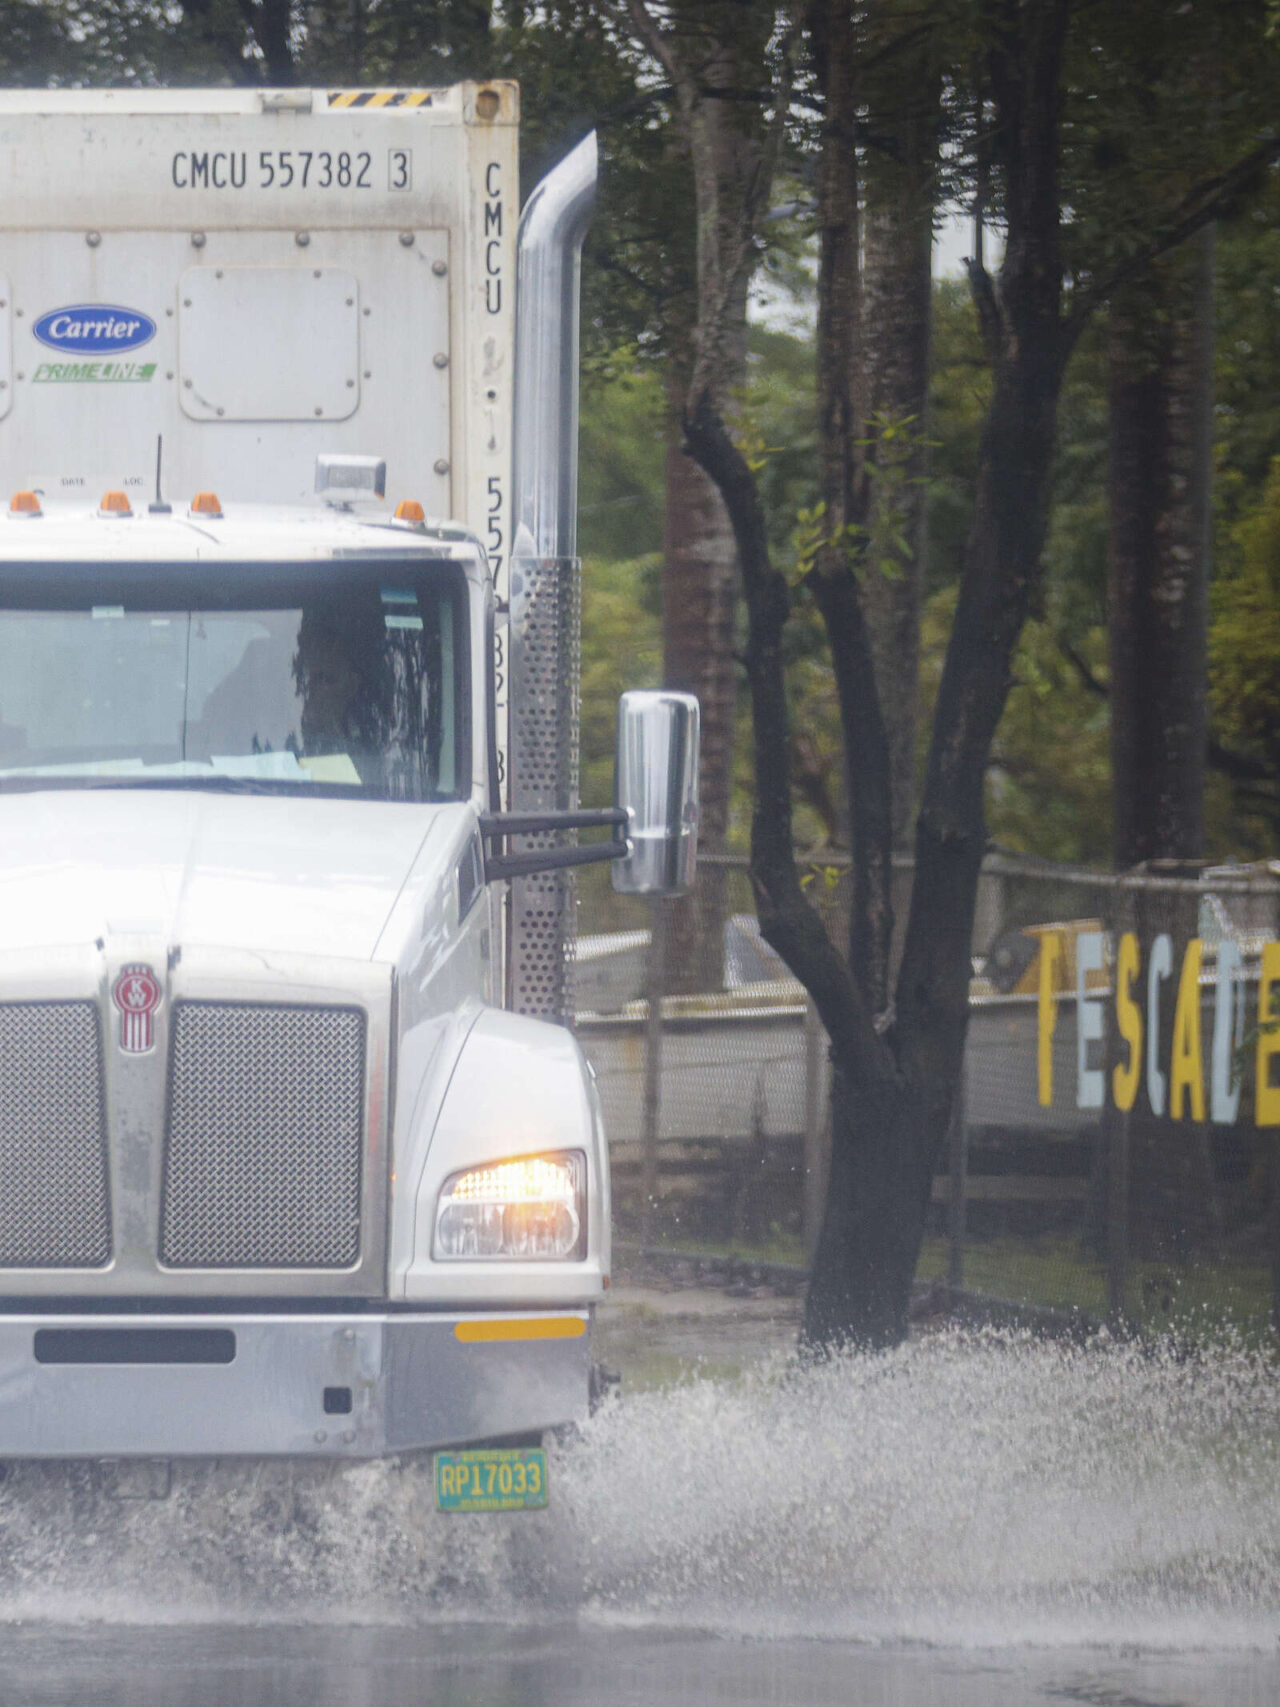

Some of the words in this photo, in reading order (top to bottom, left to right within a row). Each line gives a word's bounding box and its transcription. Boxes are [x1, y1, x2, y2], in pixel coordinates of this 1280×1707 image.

[172, 152, 246, 188] CMCU
[259, 152, 372, 188] 557382
[393, 152, 408, 188] 3
[485, 163, 502, 314] CMCU
[48, 316, 140, 338] Carrier
[442, 1462, 541, 1496] RP17033
